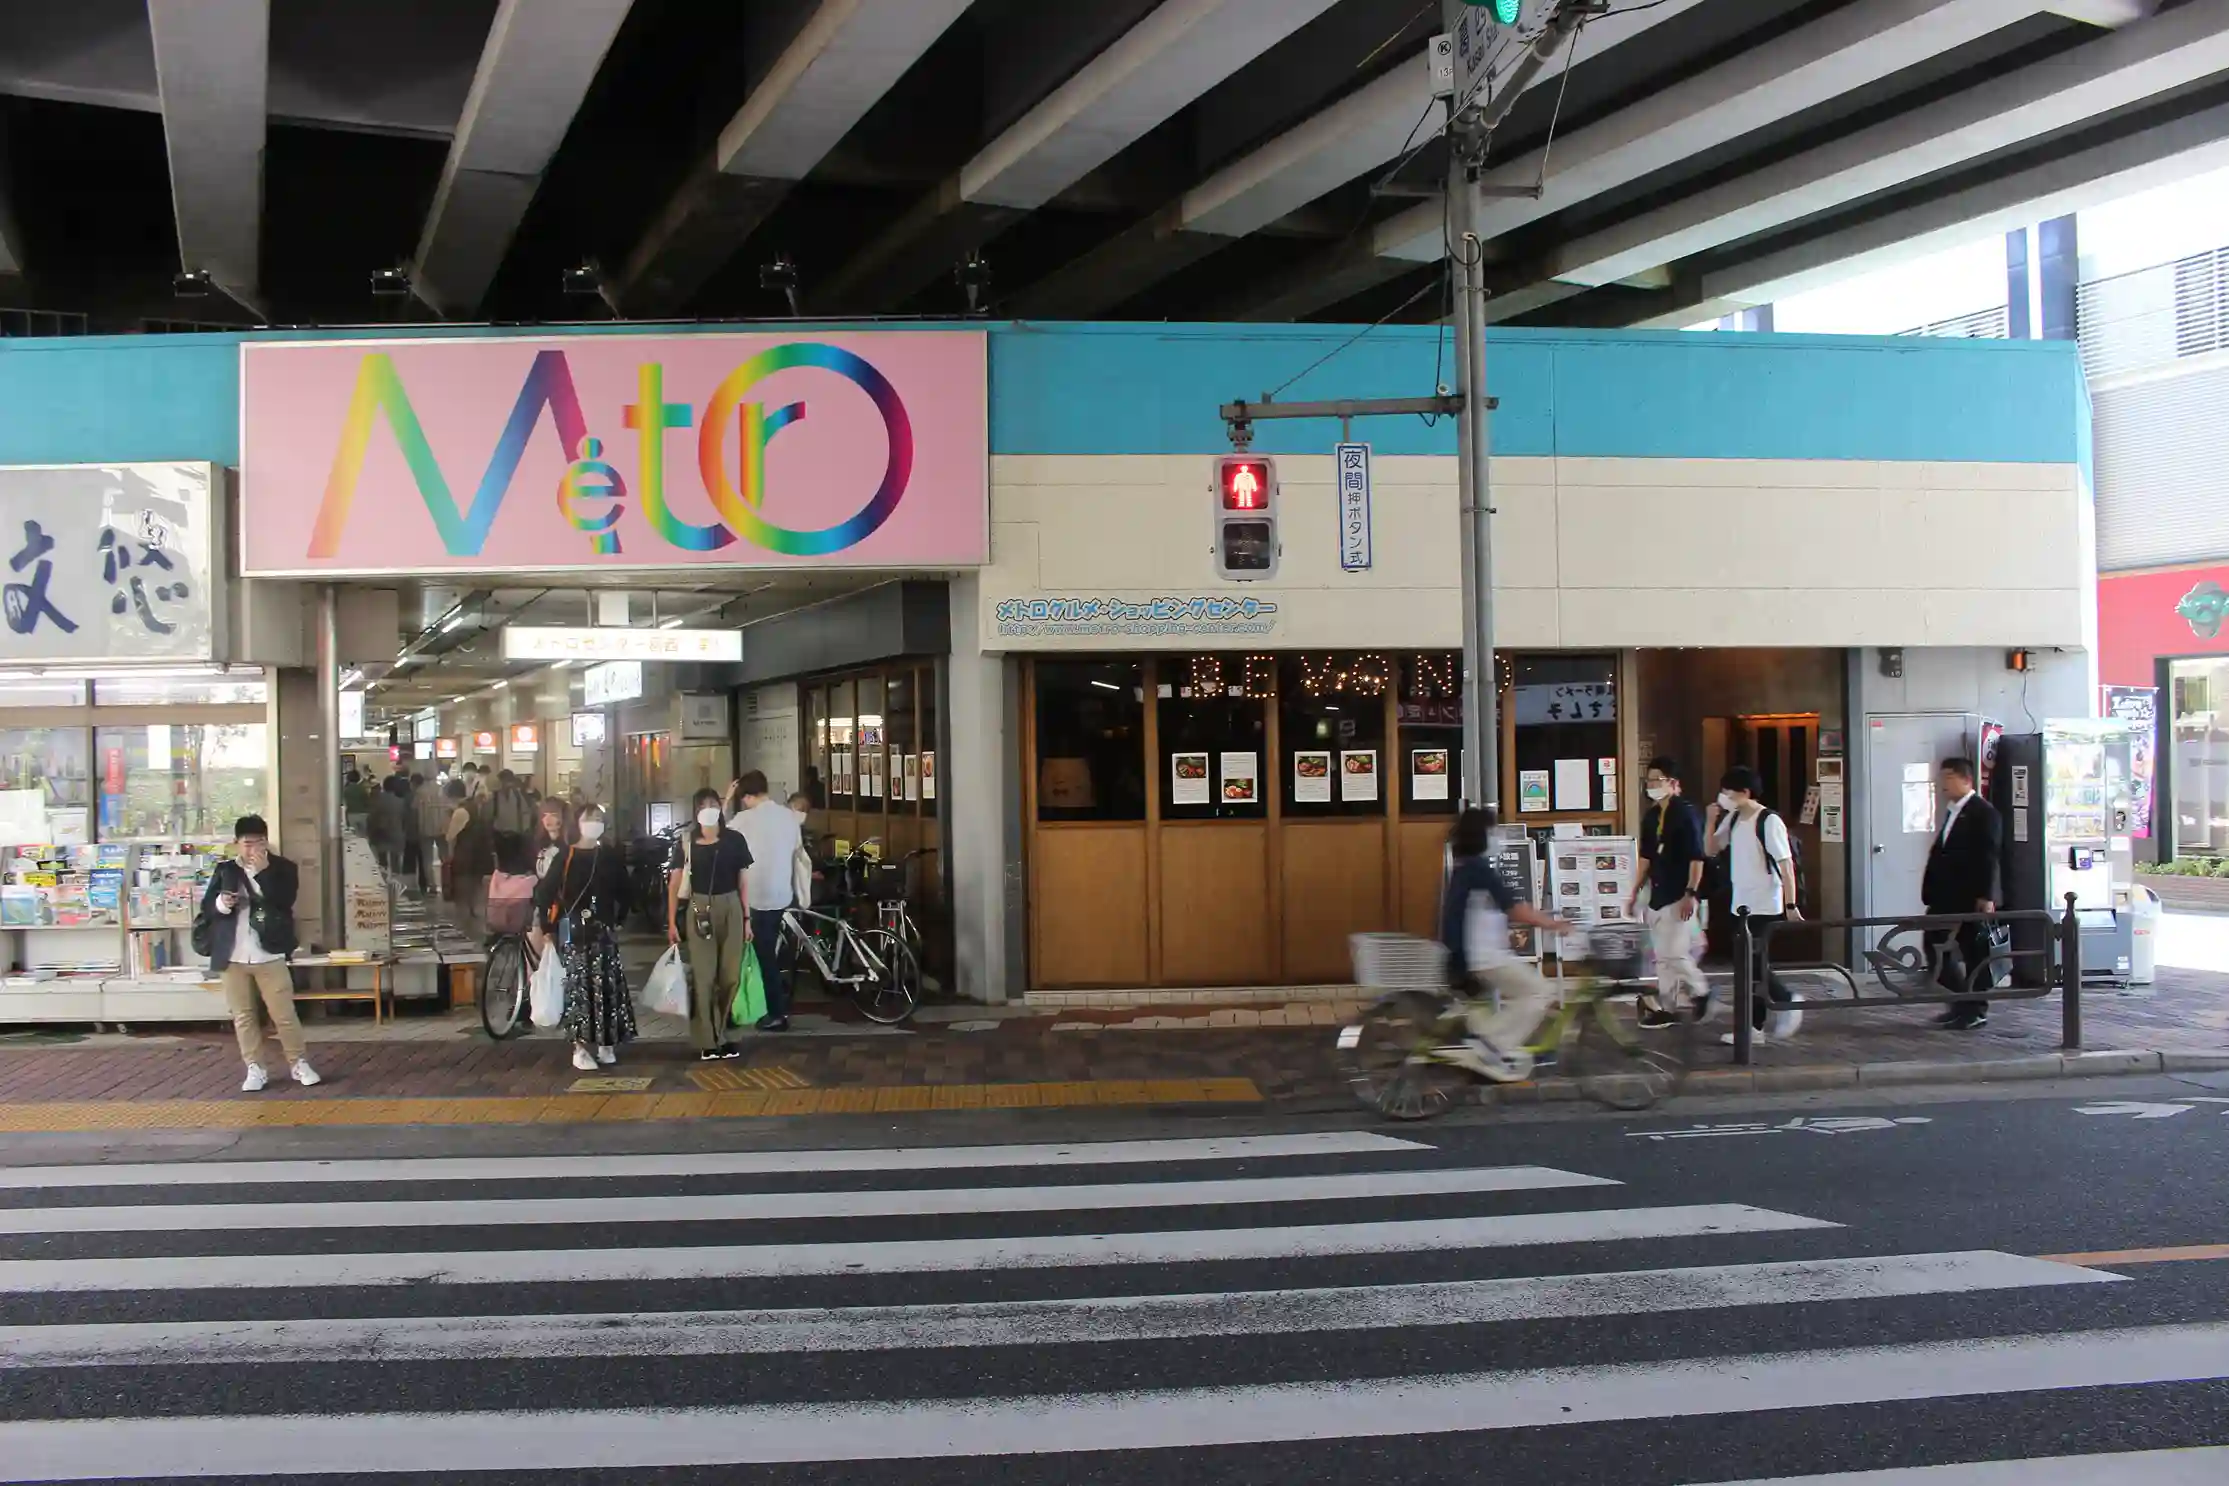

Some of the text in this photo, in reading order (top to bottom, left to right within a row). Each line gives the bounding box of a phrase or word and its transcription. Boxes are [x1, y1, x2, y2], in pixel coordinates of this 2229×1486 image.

[1345, 450, 1363, 564] 夜間押ボタン式
